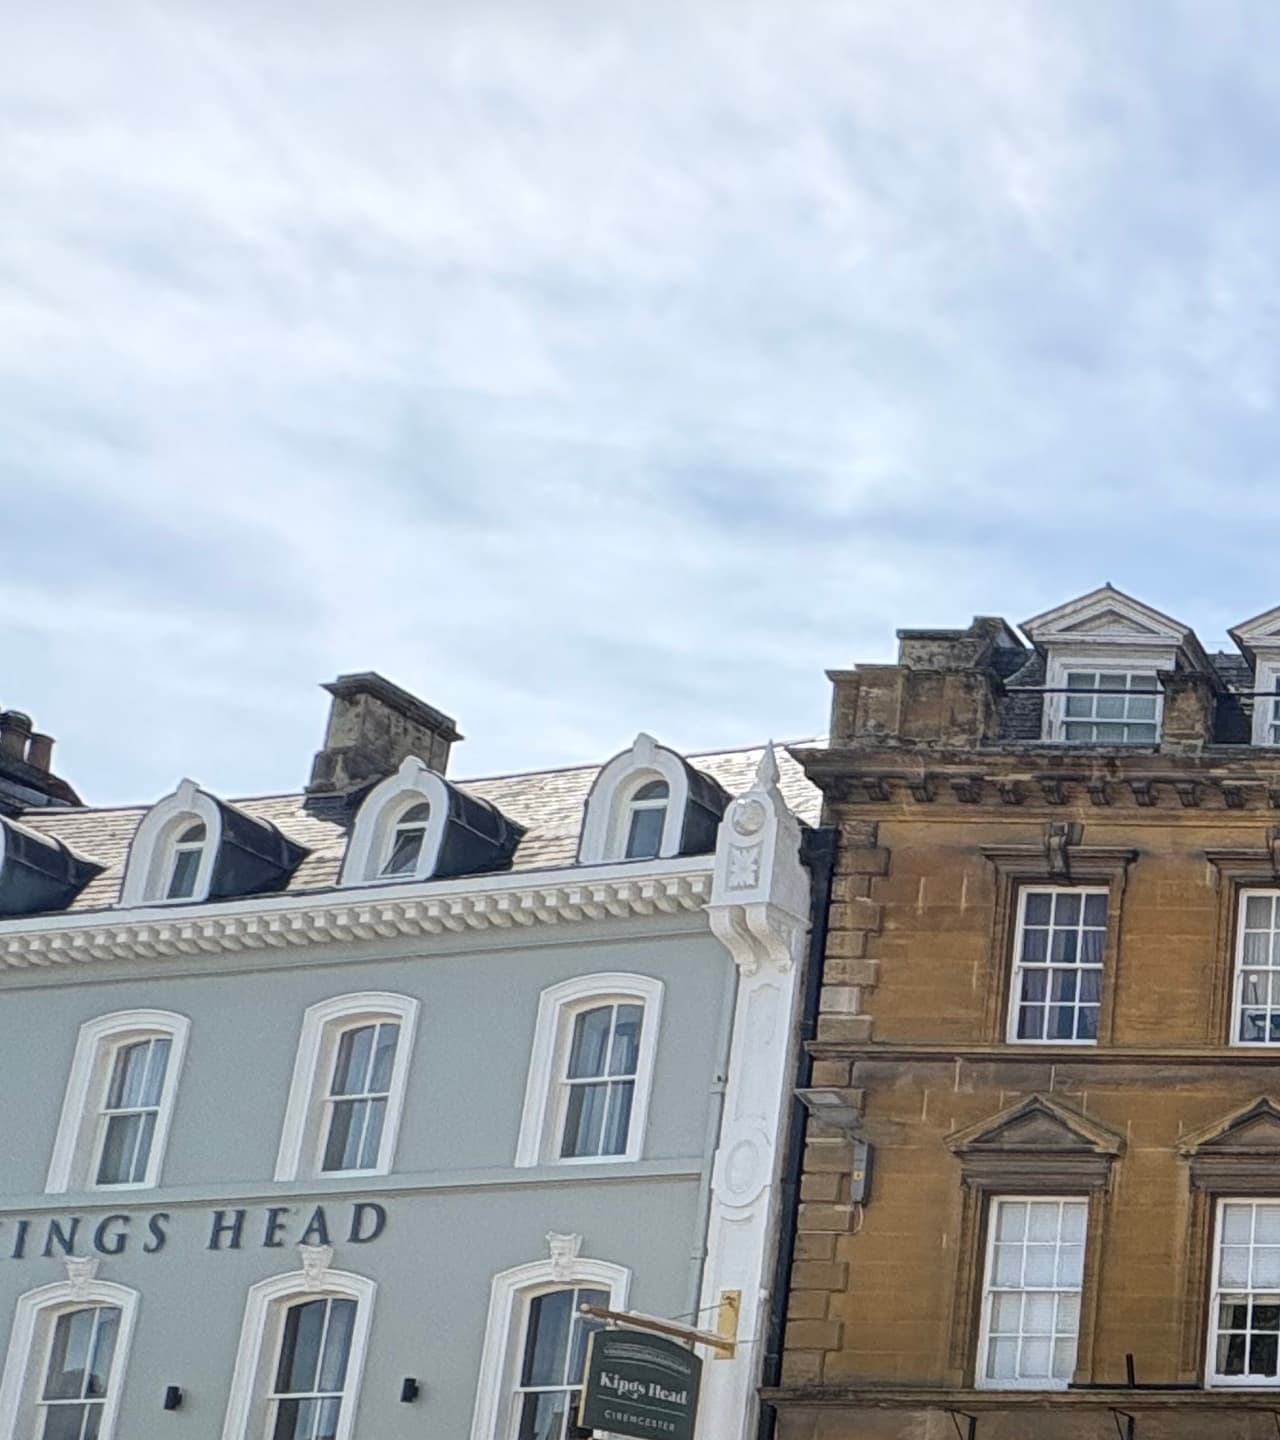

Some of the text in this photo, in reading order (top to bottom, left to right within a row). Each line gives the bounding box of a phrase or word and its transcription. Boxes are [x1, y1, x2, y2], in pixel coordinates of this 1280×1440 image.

[2, 1202, 388, 1259] INGS HEAD
[600, 1371, 688, 1405] Kings Head
